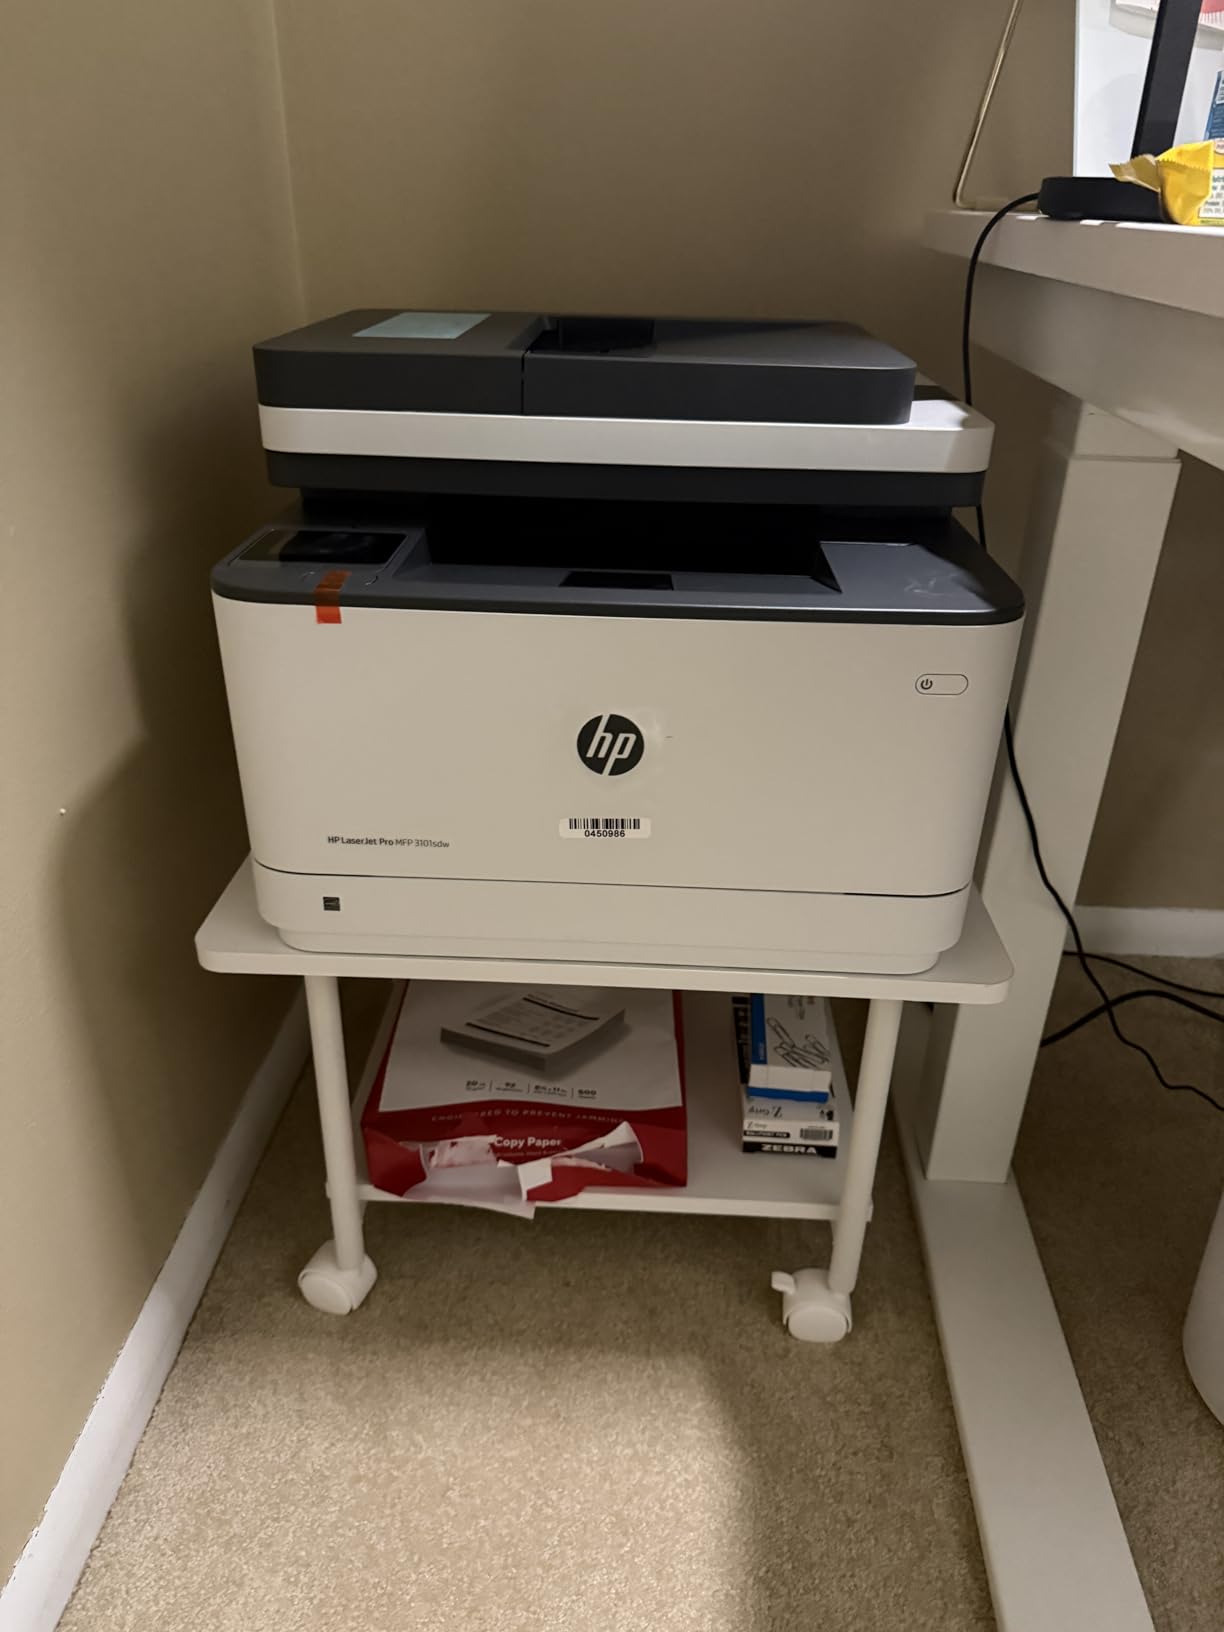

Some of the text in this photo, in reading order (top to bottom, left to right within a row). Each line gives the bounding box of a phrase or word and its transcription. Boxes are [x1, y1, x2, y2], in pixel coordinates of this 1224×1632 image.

[586, 713, 637, 776] hp
[583, 829, 626, 838] 0450986
[327, 835, 450, 848] HP LaserJet Pro MFP 3101sdw
[494, 1136, 562, 1149] Copy Paper
[760, 1143, 817, 1154] ZEBRA
